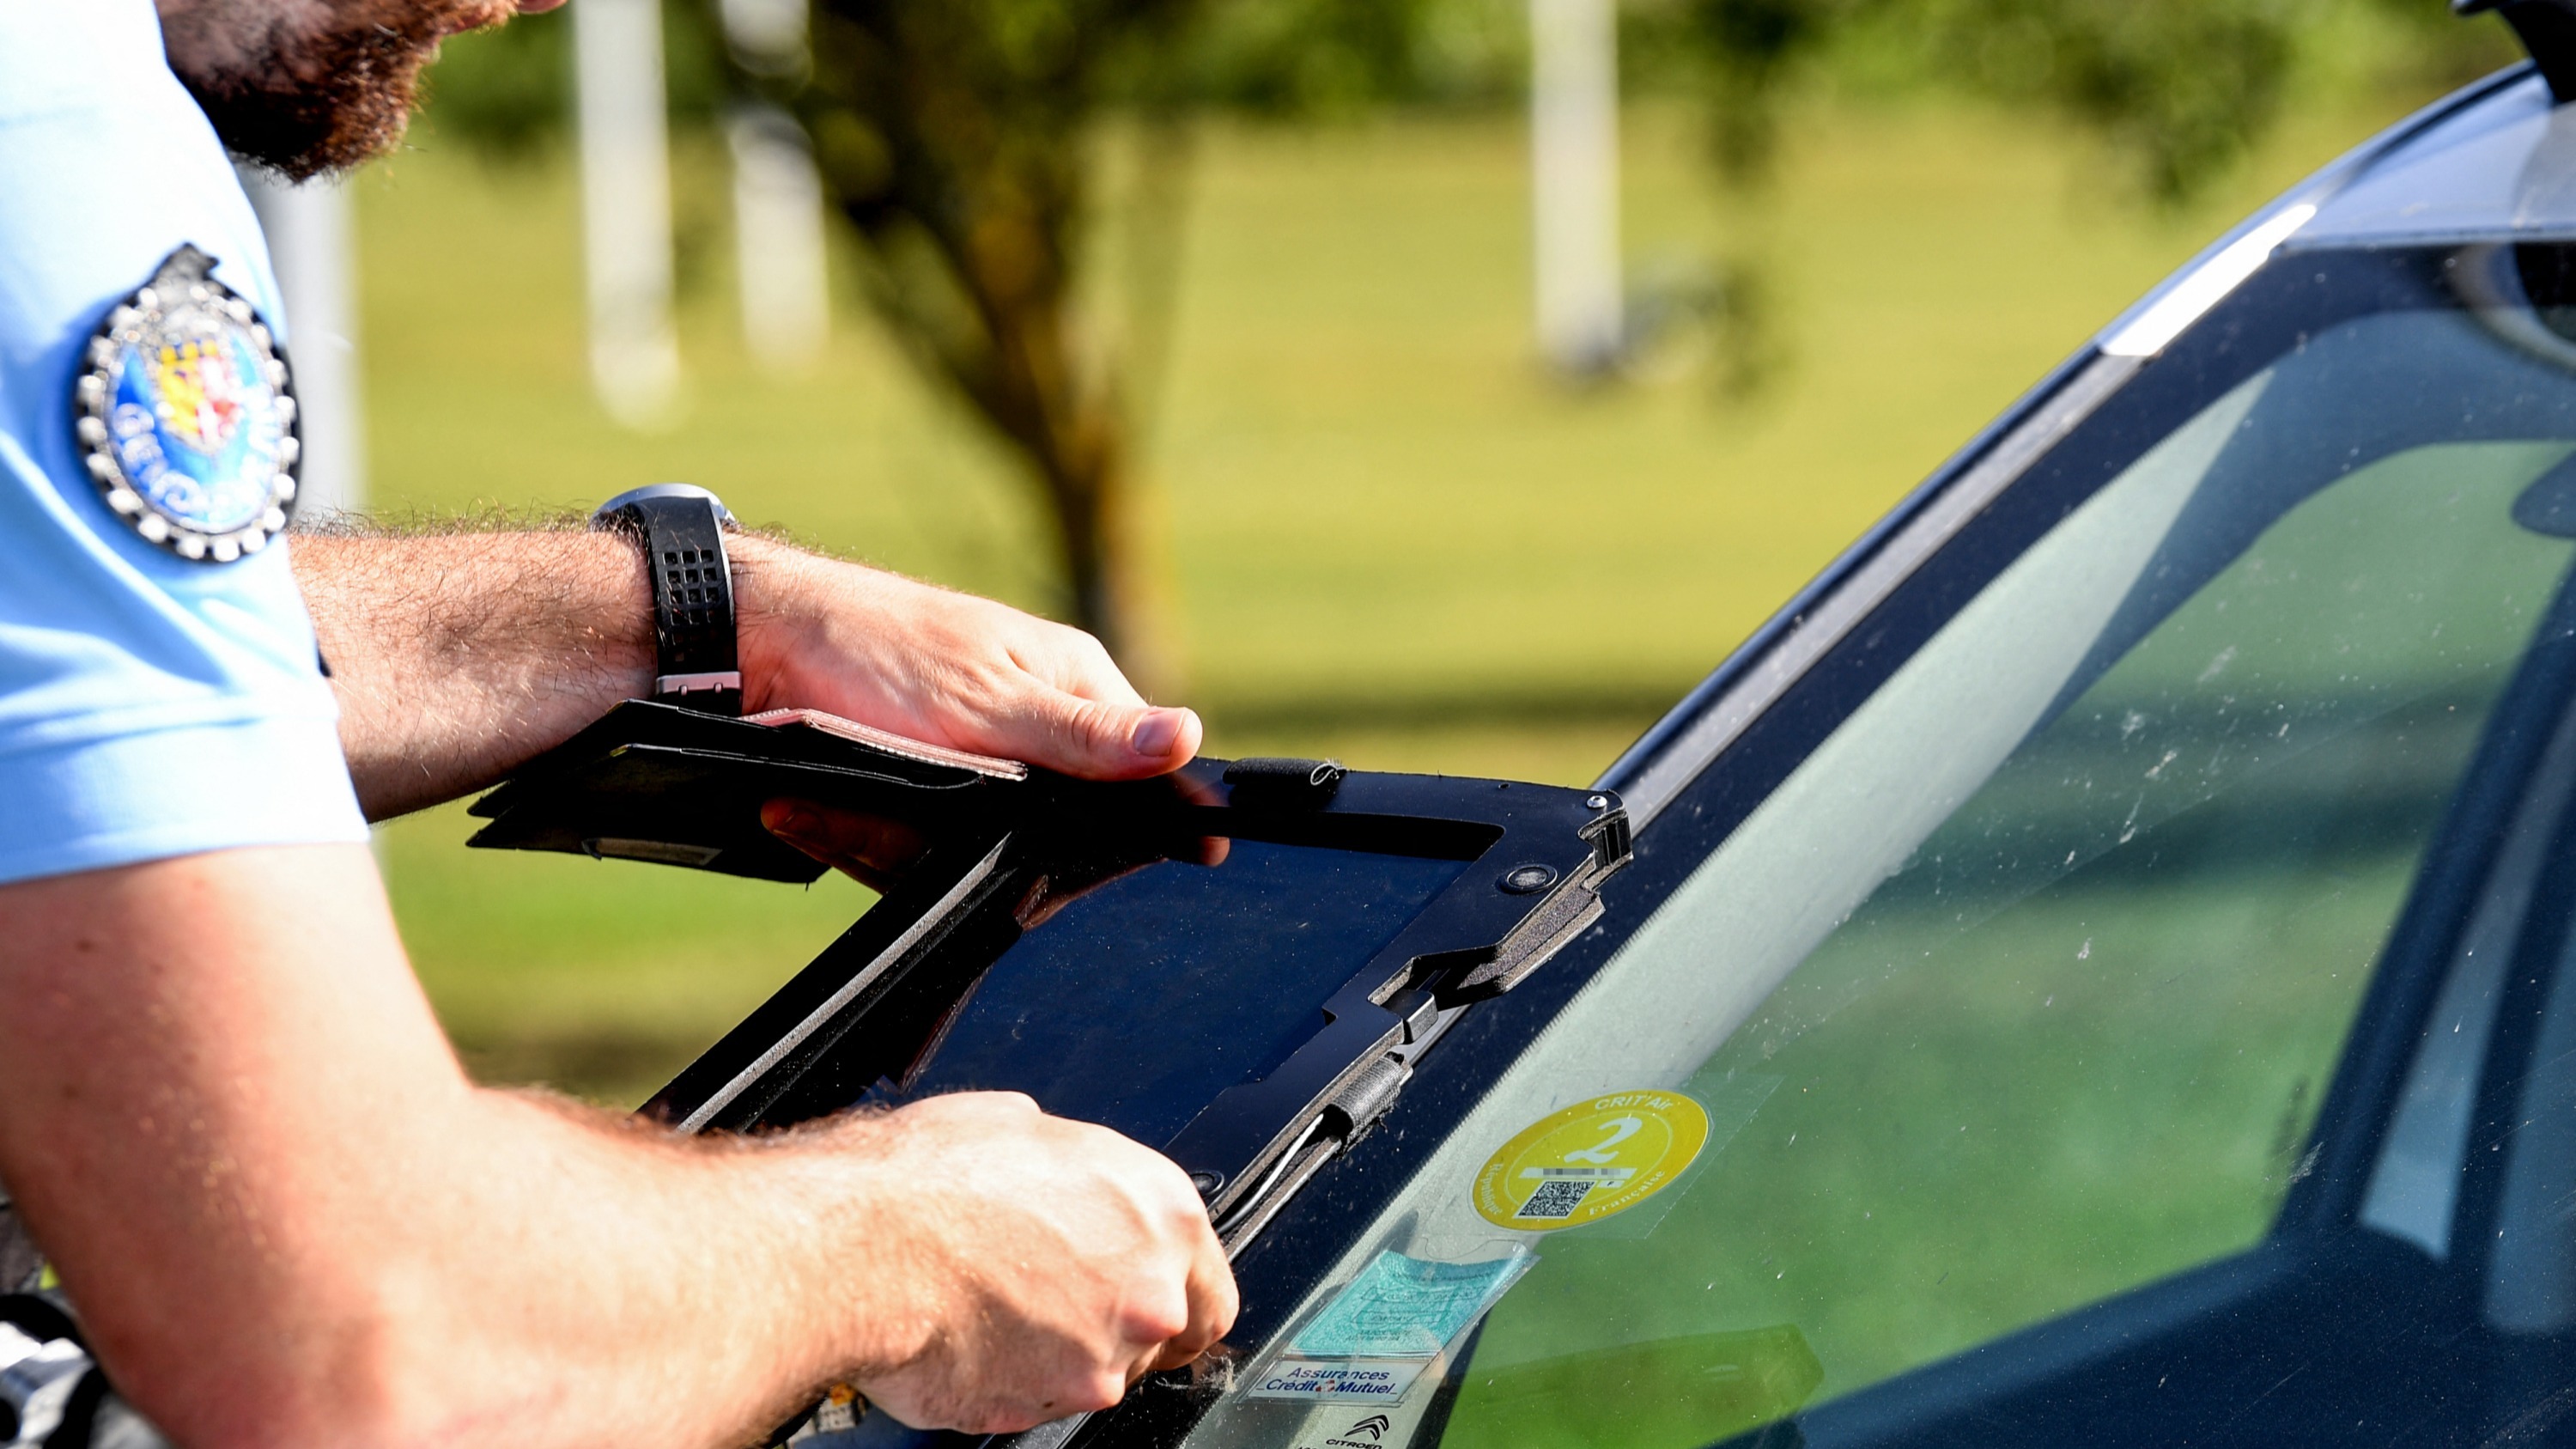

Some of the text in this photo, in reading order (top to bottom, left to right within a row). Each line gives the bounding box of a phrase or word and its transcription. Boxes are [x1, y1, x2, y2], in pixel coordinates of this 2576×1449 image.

[1595, 1094, 1674, 1111] CRIT'Air
[1563, 1117, 1643, 1164] 2
[1288, 1367, 1390, 1380] Assurances
[1266, 1379, 1396, 1394] Crédit Mutuel
